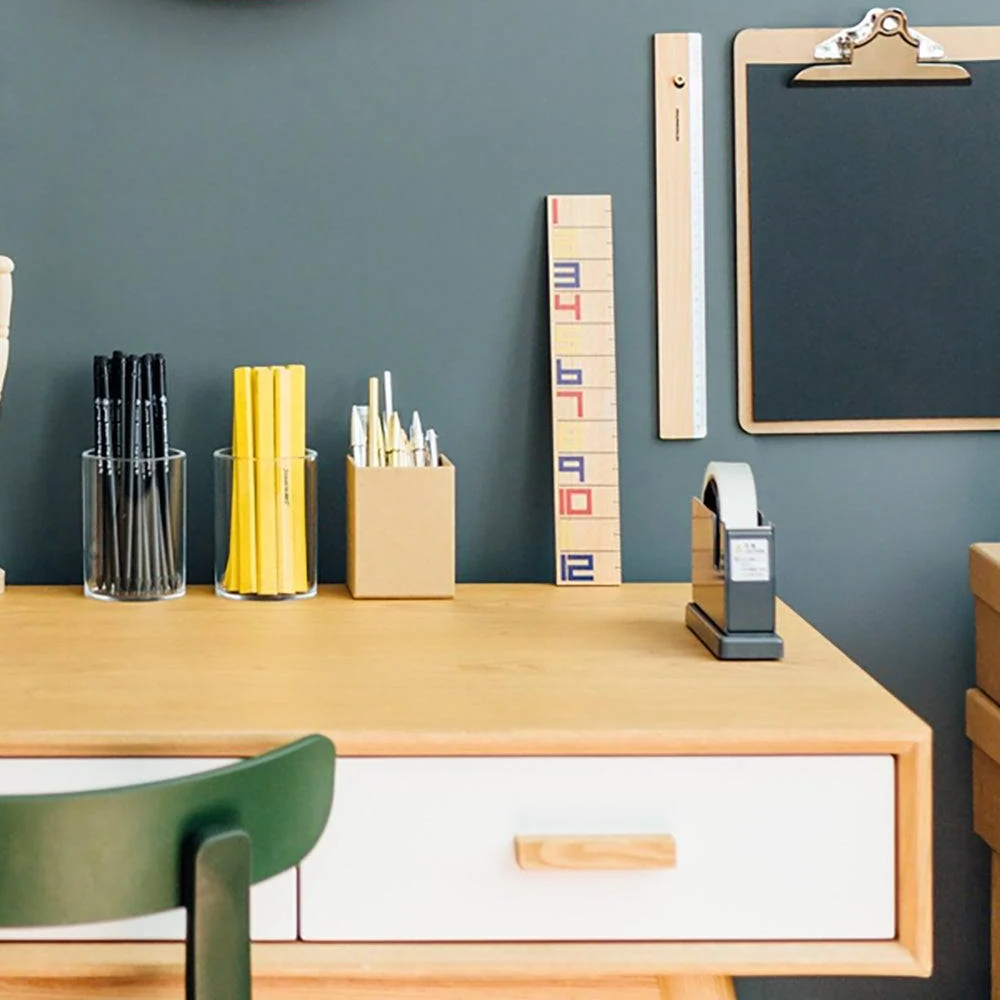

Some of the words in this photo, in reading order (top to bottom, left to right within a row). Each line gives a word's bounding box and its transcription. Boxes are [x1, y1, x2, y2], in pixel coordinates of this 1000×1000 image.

[551, 198, 559, 224] 1
[553, 262, 581, 289] 3
[554, 294, 581, 321] 4
[556, 359, 583, 386] 6
[557, 391, 584, 418] 7
[558, 456, 585, 482] 9
[559, 488, 593, 516] 10
[561, 554, 594, 582] 12
